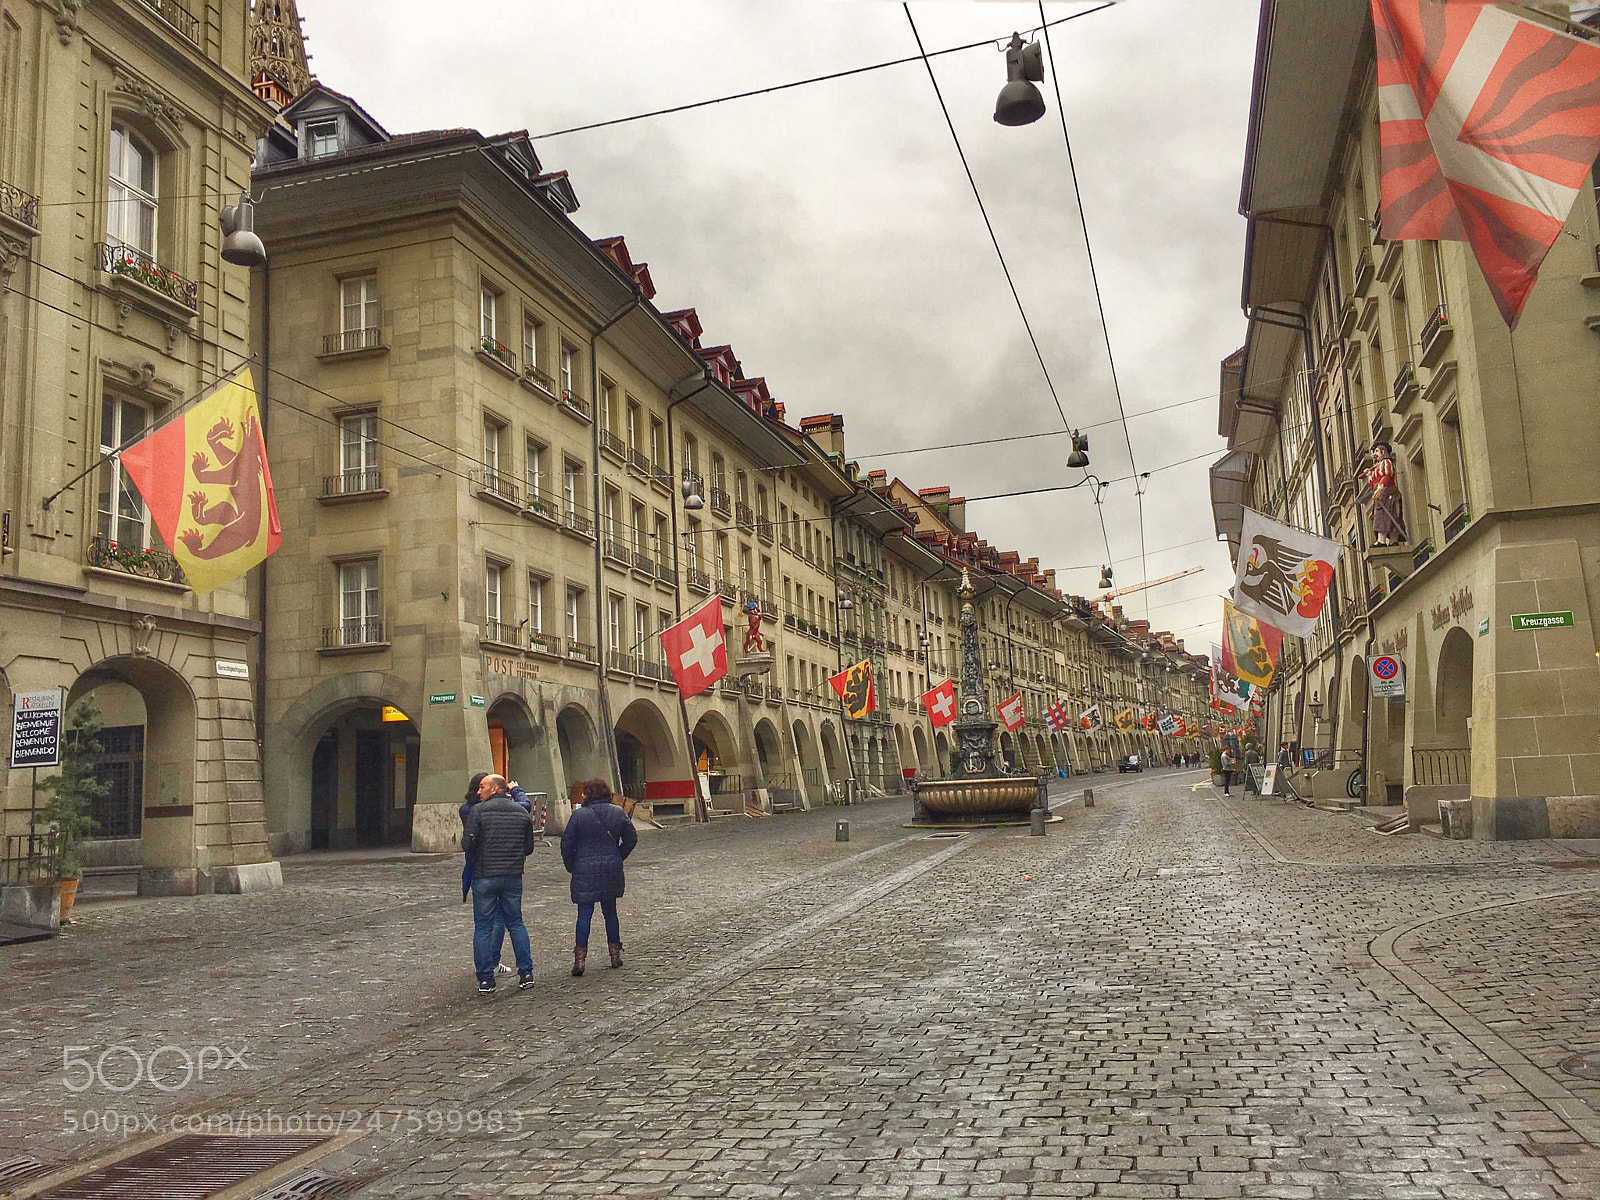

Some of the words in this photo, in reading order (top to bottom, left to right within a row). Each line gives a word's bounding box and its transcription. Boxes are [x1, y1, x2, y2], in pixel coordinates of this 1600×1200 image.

[1520, 616, 1565, 627] Kreuzgasse
[486, 655, 514, 676] POST
[16, 710, 59, 720] WILLKOMMEN
[16, 719, 55, 731] BIENVENUE
[15, 727, 51, 738] WELCOME
[15, 736, 56, 748] BENVENUTO
[15, 747, 55, 759] BIENVENIDO
